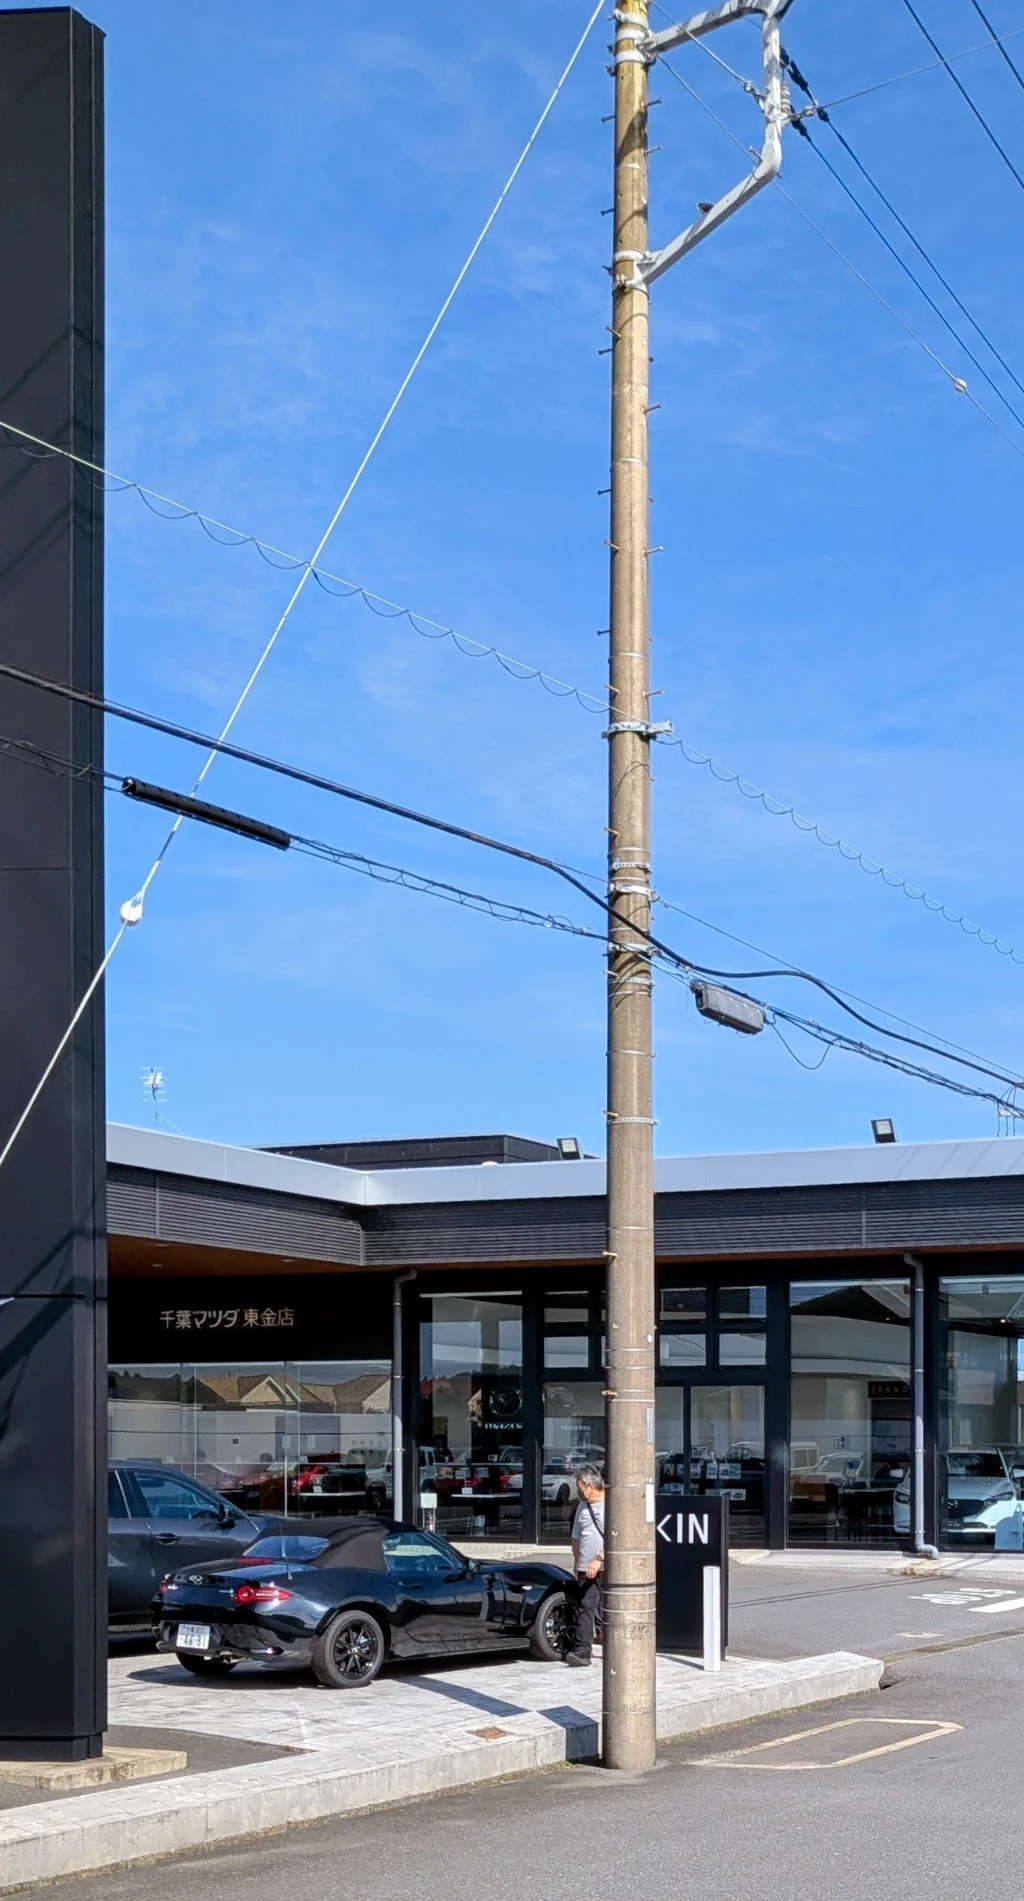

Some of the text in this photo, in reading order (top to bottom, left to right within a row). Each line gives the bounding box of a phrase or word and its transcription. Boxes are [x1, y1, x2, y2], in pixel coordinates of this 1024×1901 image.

[159, 1308, 295, 1329] 千葉マツダ 東金店
[676, 1513, 709, 1544] IN
